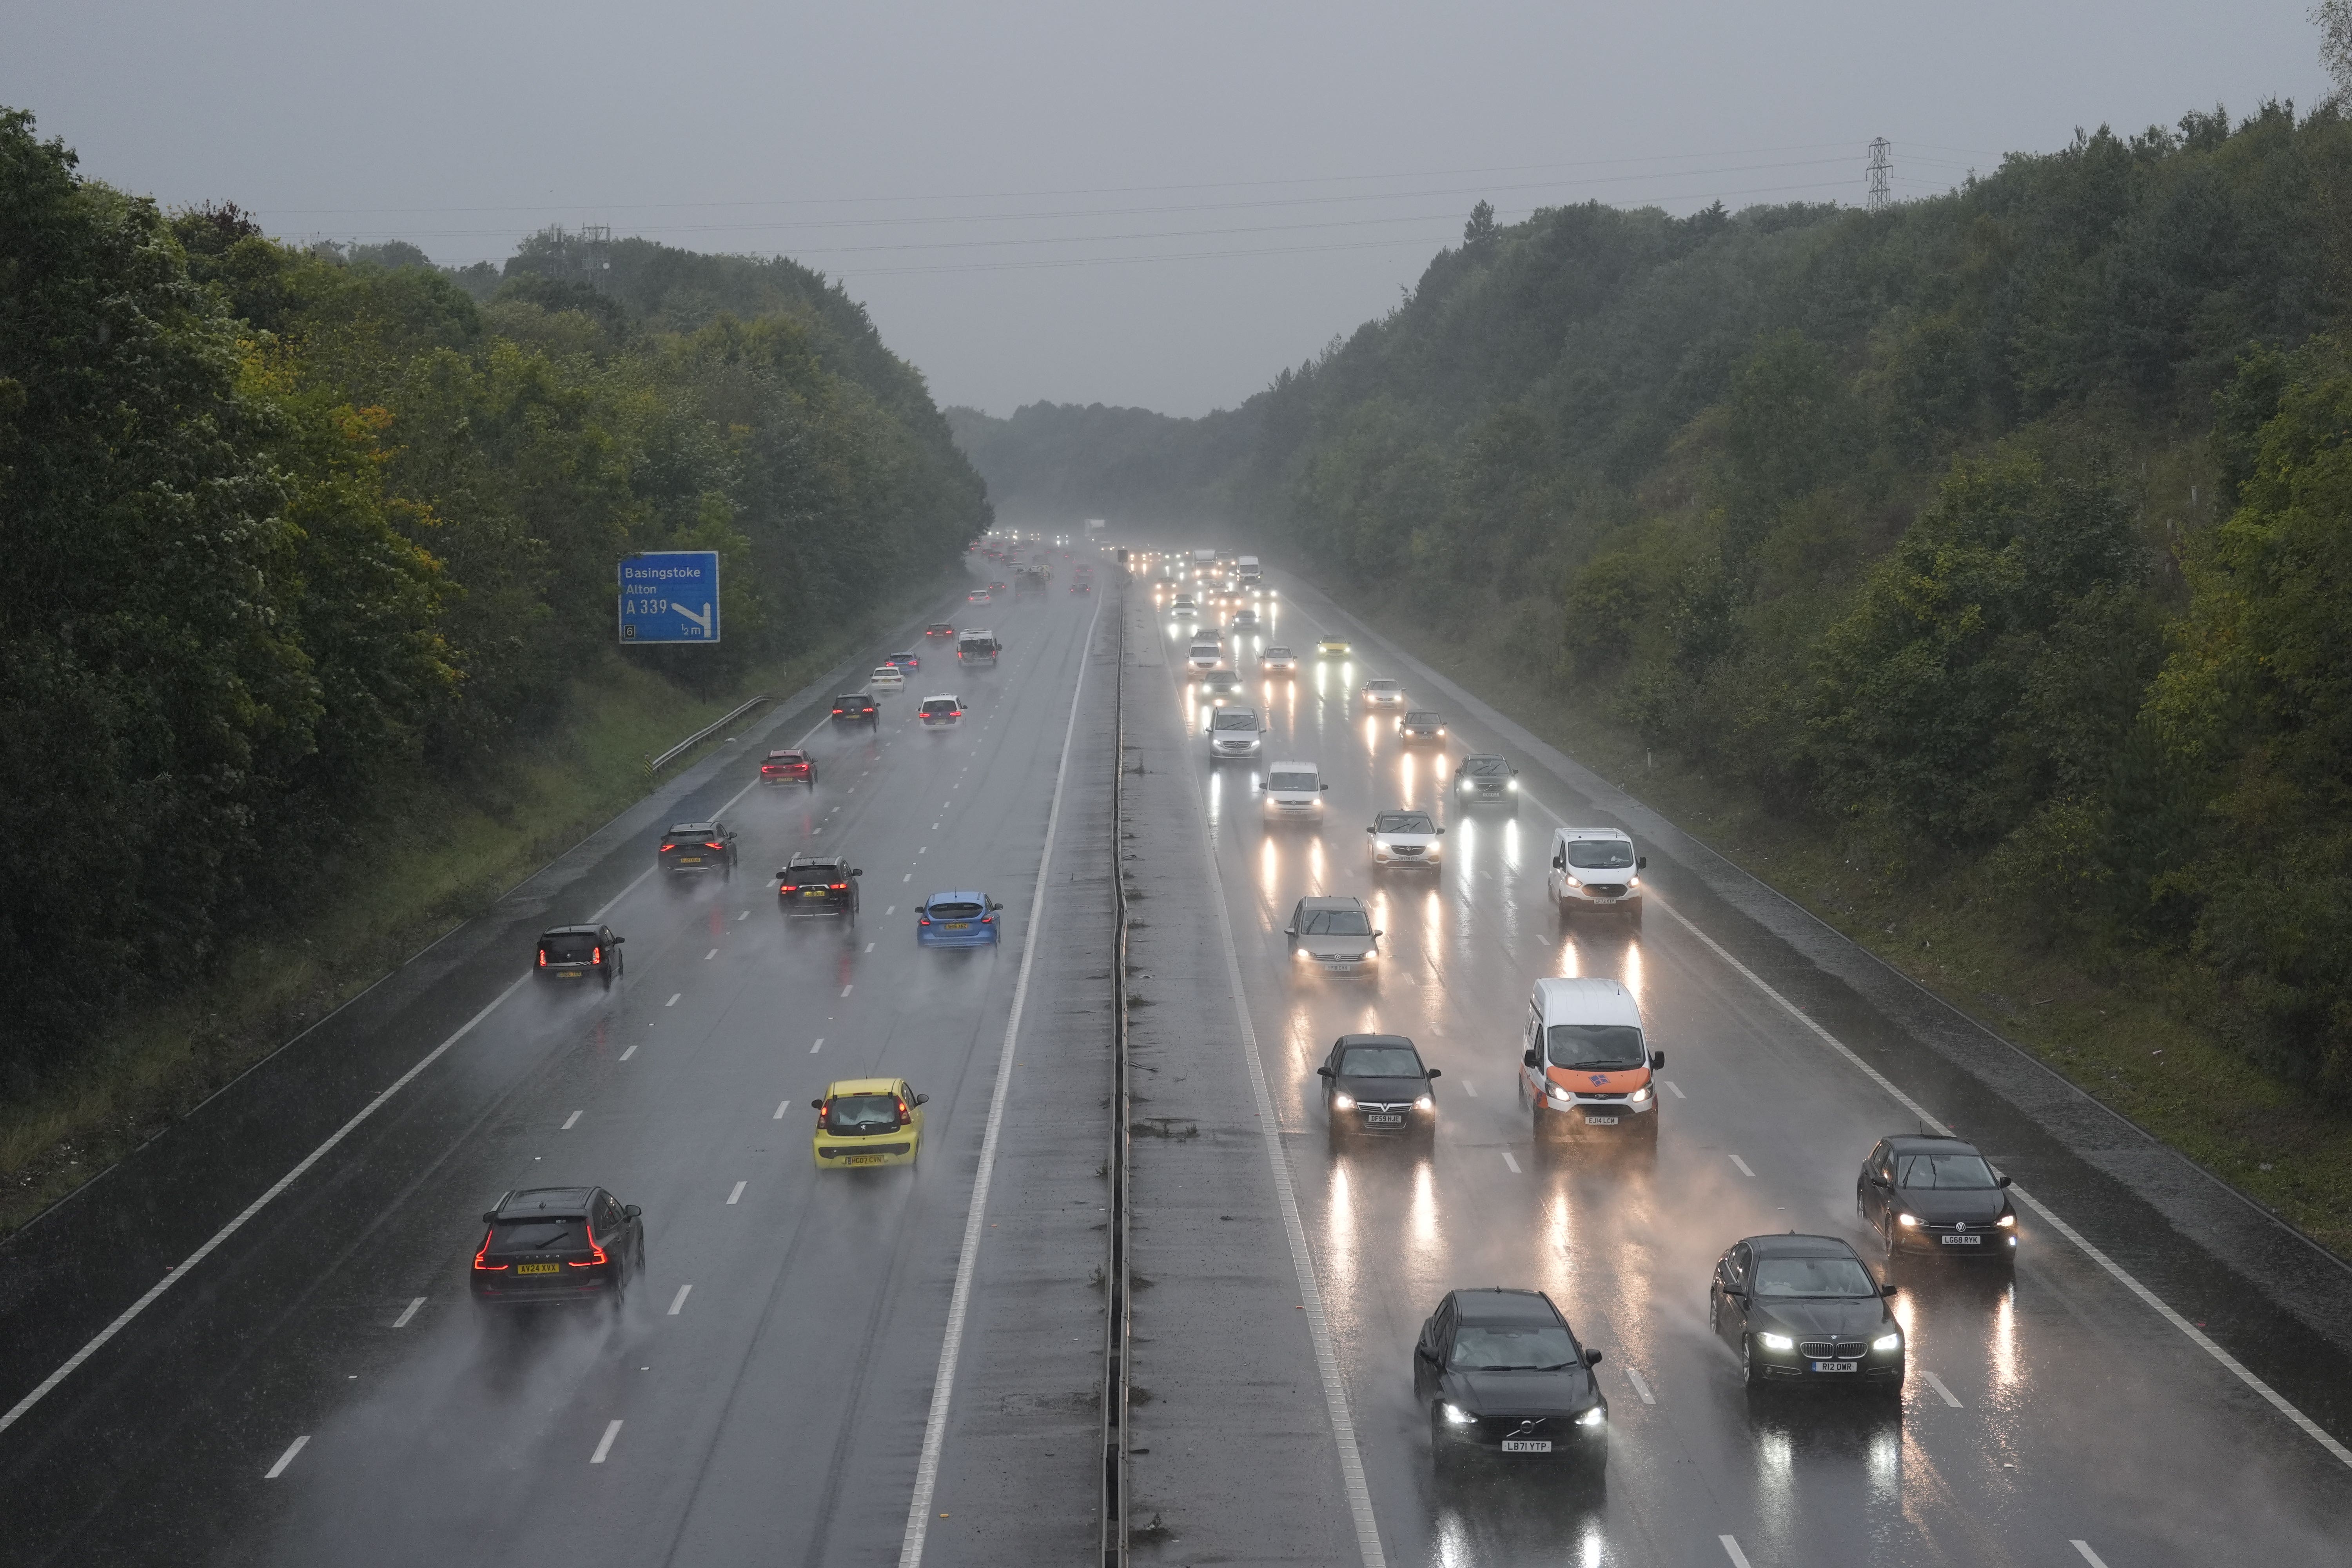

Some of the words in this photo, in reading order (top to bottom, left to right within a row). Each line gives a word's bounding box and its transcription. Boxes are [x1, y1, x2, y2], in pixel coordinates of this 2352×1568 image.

[625, 567, 701, 579] Basingstoke
[626, 584, 656, 594] Alton
[626, 600, 635, 614] A
[641, 599, 666, 614] 339
[627, 627, 633, 635] 6
[1508, 1442, 1527, 1450] LB71
[1530, 1443, 1546, 1451] YTP
